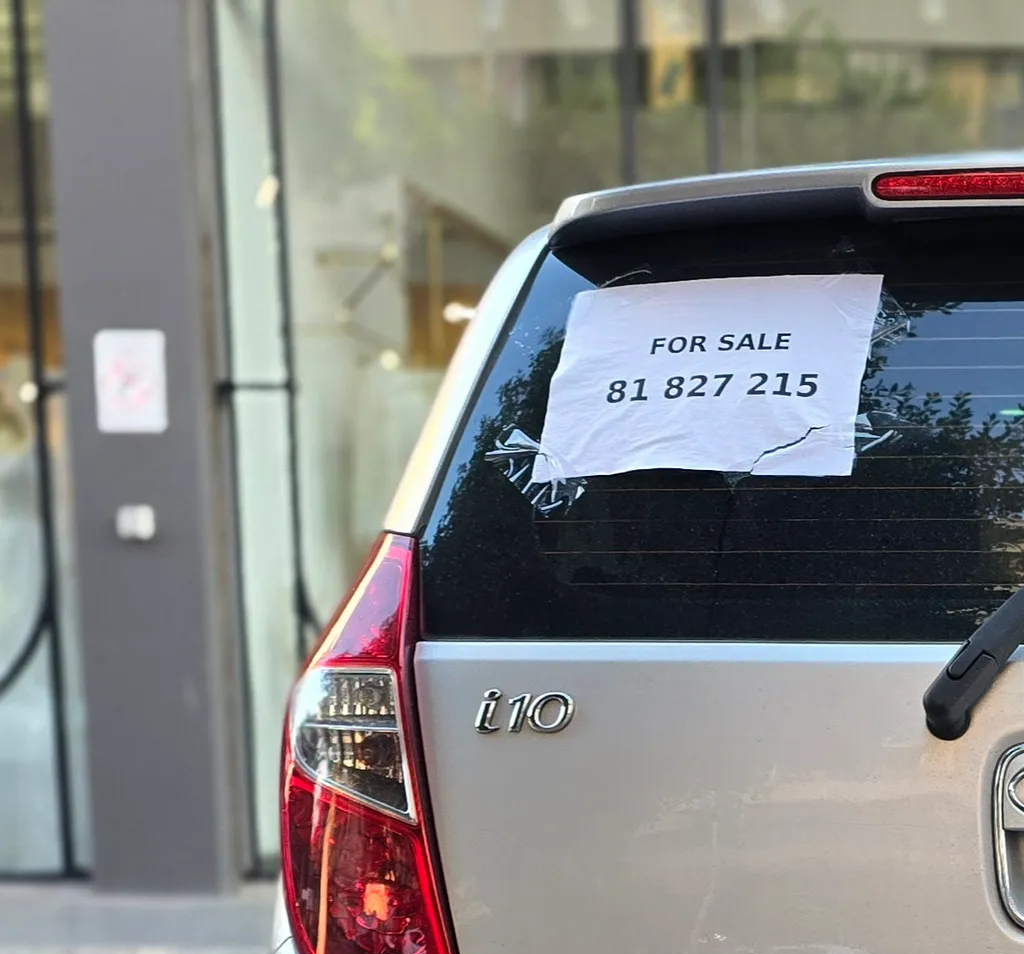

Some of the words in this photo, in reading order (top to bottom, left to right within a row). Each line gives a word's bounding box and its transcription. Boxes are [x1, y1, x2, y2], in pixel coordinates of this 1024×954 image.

[650, 335, 707, 355] FOR
[717, 332, 792, 351] SALE
[606, 378, 649, 403] 81
[663, 374, 733, 401] 827
[747, 372, 819, 399] 215
[474, 688, 576, 734] i10
